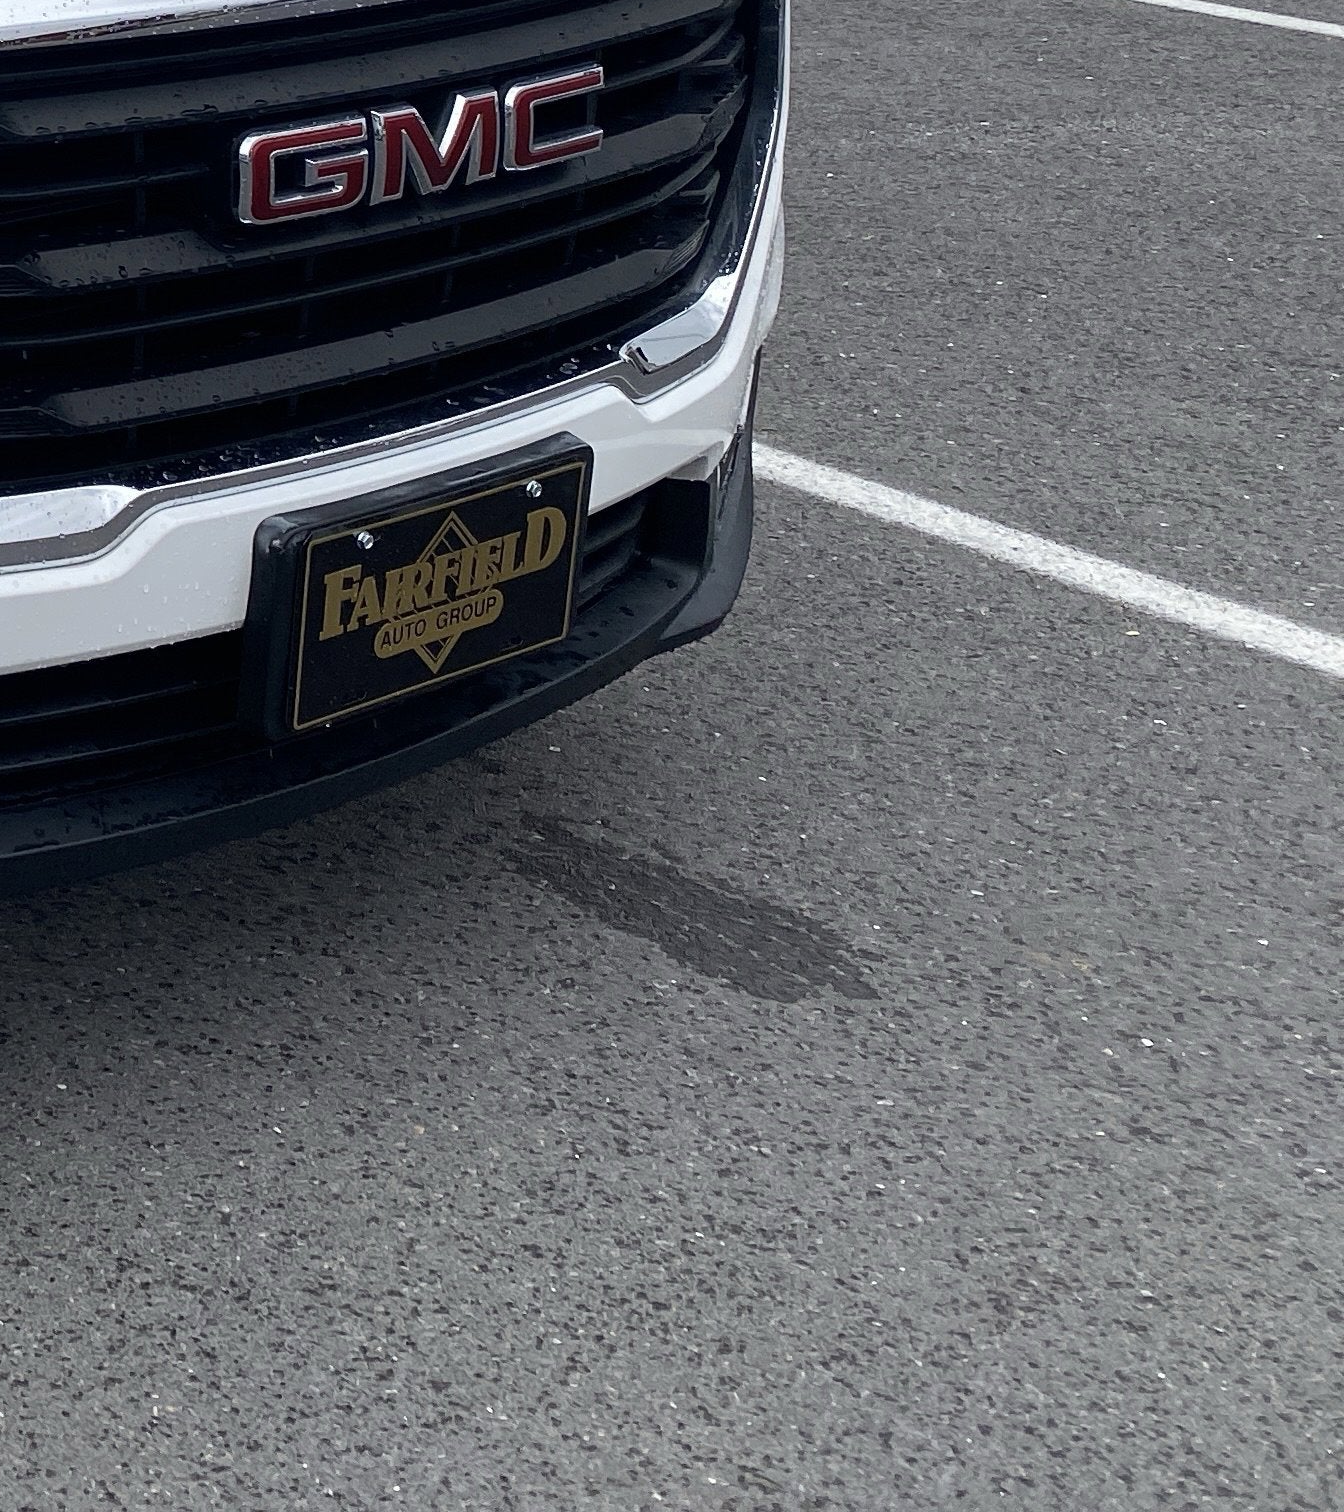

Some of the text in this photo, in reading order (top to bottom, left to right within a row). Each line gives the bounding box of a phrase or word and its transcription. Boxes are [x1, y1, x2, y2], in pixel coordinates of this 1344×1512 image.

[238, 65, 605, 226] GMC
[319, 506, 567, 641] FAIRFIELD
[380, 596, 497, 650] AUTO GROUP
